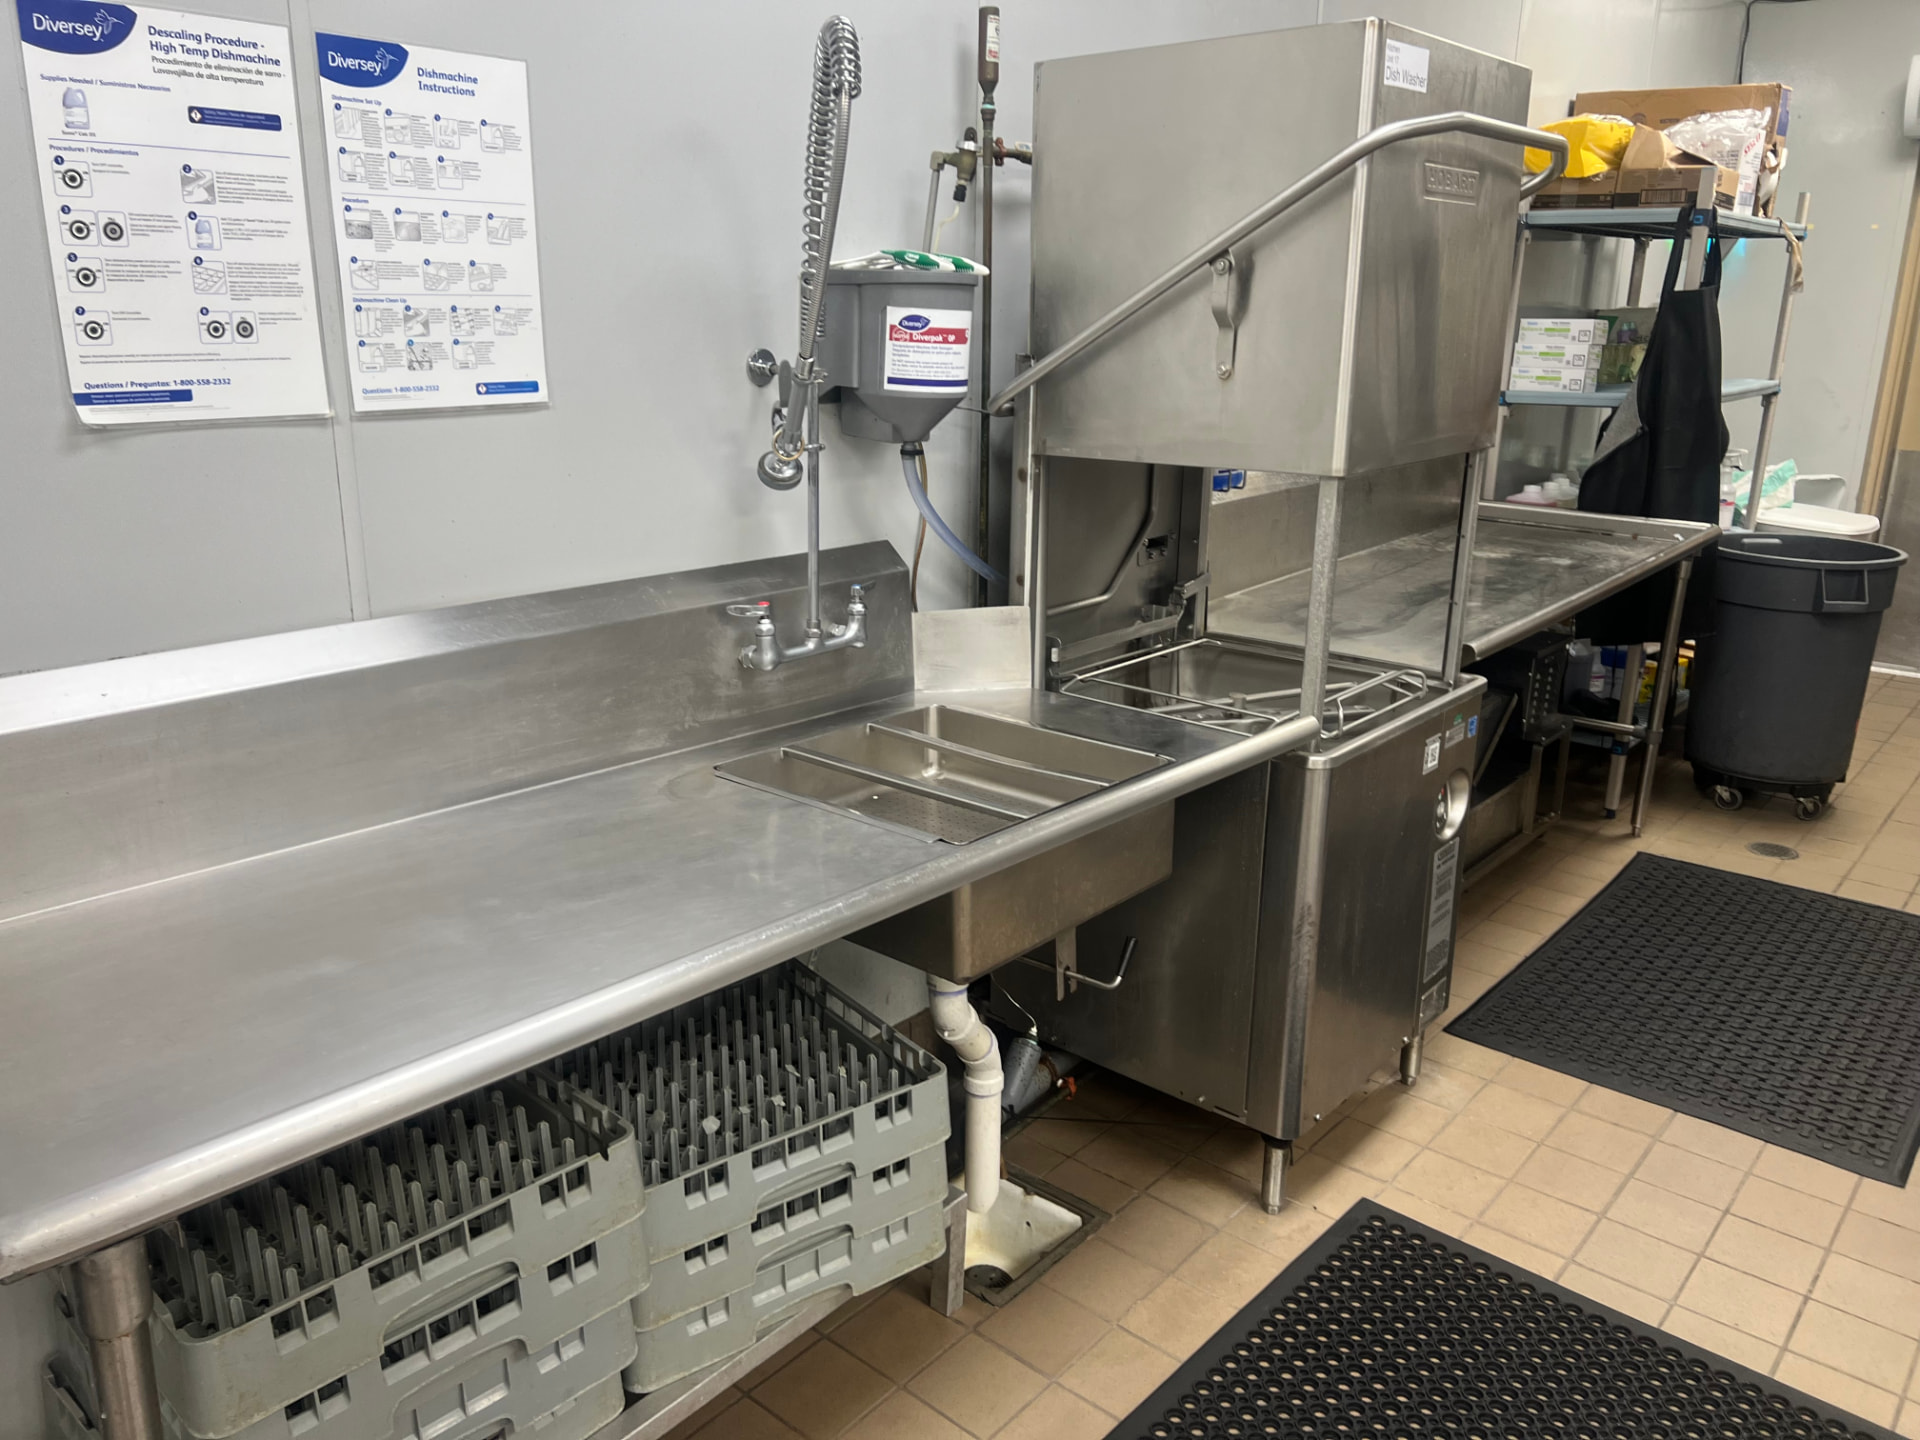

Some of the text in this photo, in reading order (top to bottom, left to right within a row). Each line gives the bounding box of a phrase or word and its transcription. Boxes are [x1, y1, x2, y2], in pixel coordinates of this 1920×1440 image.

[32, 13, 102, 41] Diversey
[148, 25, 202, 45] Descaling
[205, 33, 258, 49] Procedure
[149, 40, 281, 66] High Temp Dishmachine
[151, 56, 202, 68] Procedimiento
[204, 61, 212, 70] de
[214, 63, 253, 74] eliminación
[255, 66, 263, 75] de
[264, 69, 281, 78] sarro
[328, 51, 381, 76] Diversey
[40, 73, 68, 83] Supplies
[68, 76, 94, 85] Needed
[99, 80, 137, 89] Suministros
[152, 67, 264, 86] Lavavajillas de alta temperatura
[417, 67, 479, 85] Dishmachine
[1386, 65, 1427, 89] Dish Washer
[418, 80, 476, 97] Instructions
[49, 144, 85, 153] Procedures
[90, 147, 139, 156] Procedimientos
[84, 381, 124, 390] Questions
[130, 380, 171, 389] Preguntas:
[173, 377, 231, 387] 1-800-558-2332
[362, 386, 393, 395] Questions:
